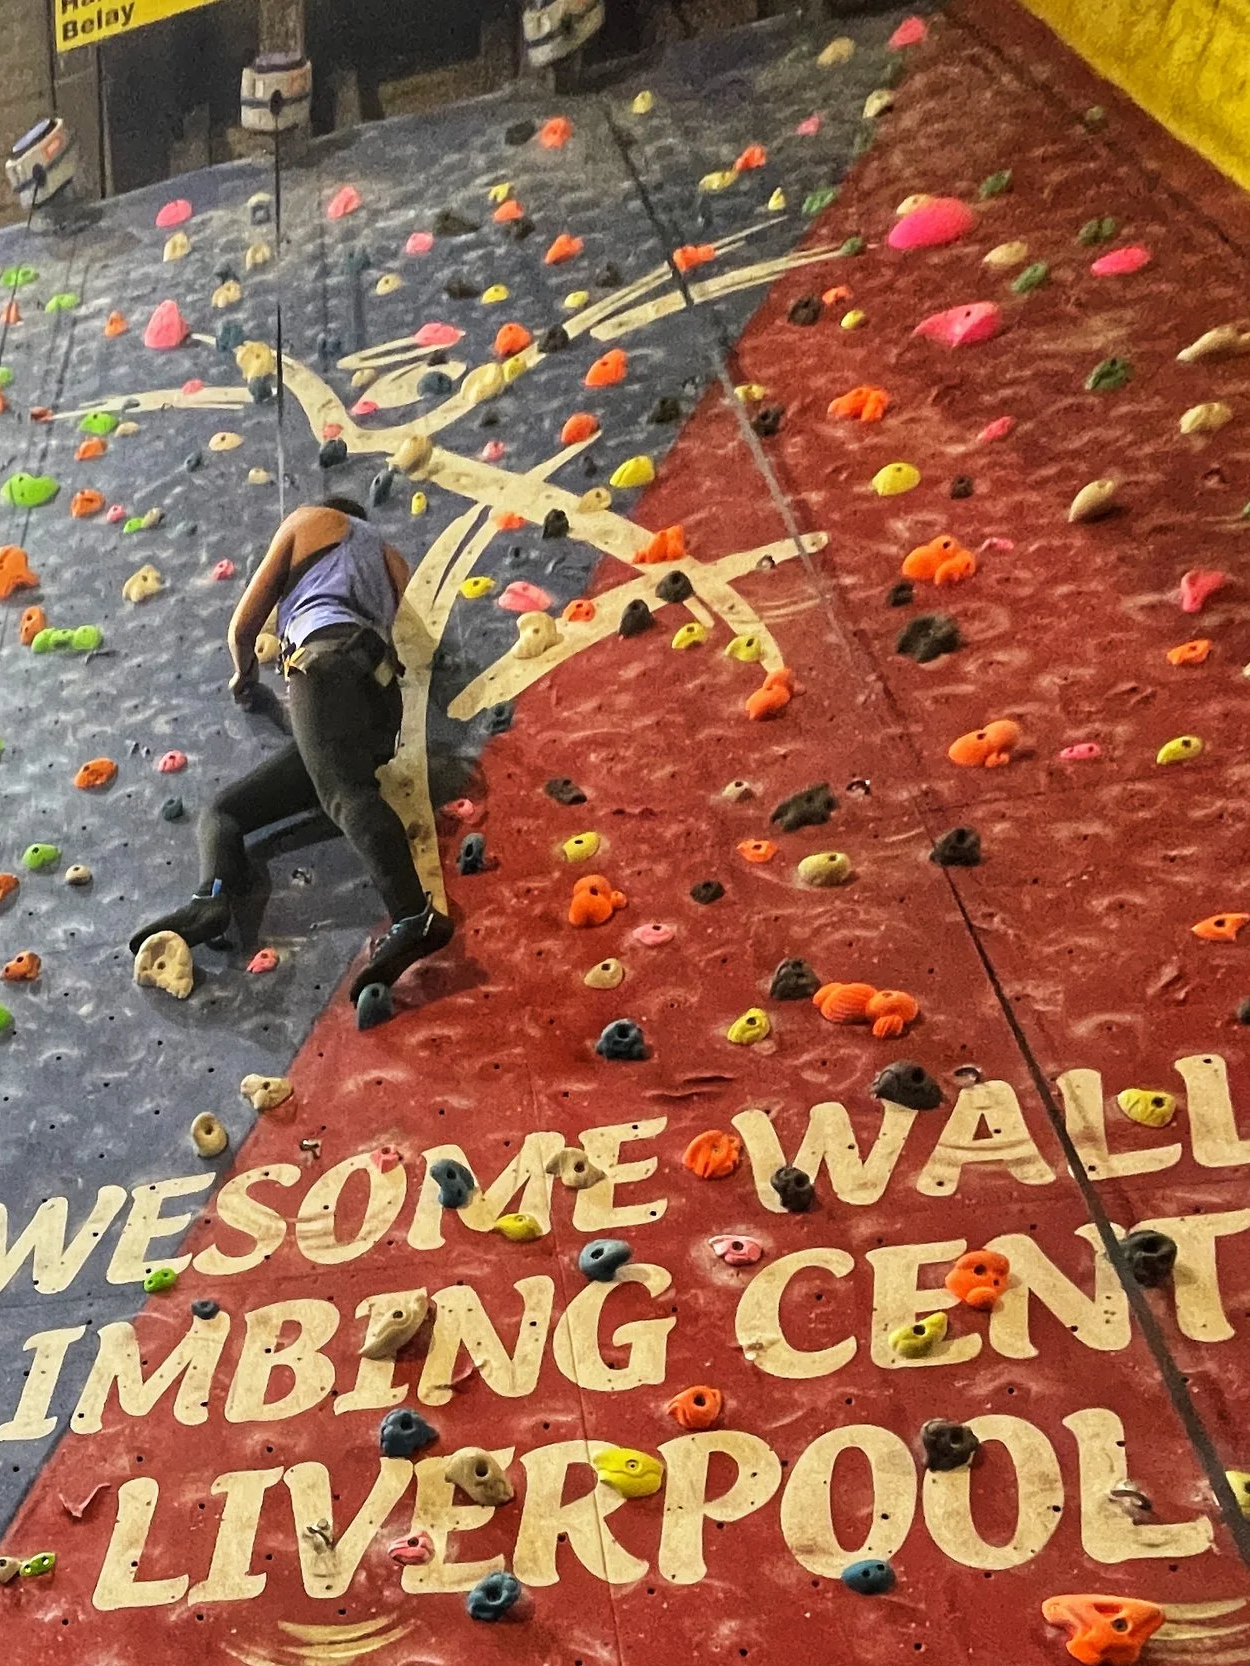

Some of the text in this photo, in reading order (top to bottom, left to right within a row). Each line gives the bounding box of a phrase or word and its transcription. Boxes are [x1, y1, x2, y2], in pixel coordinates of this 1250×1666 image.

[62, 2, 135, 42] Belay
[731, 1054, 1250, 1213] WALL
[92, 1408, 1214, 1611] LIVERPOOL
